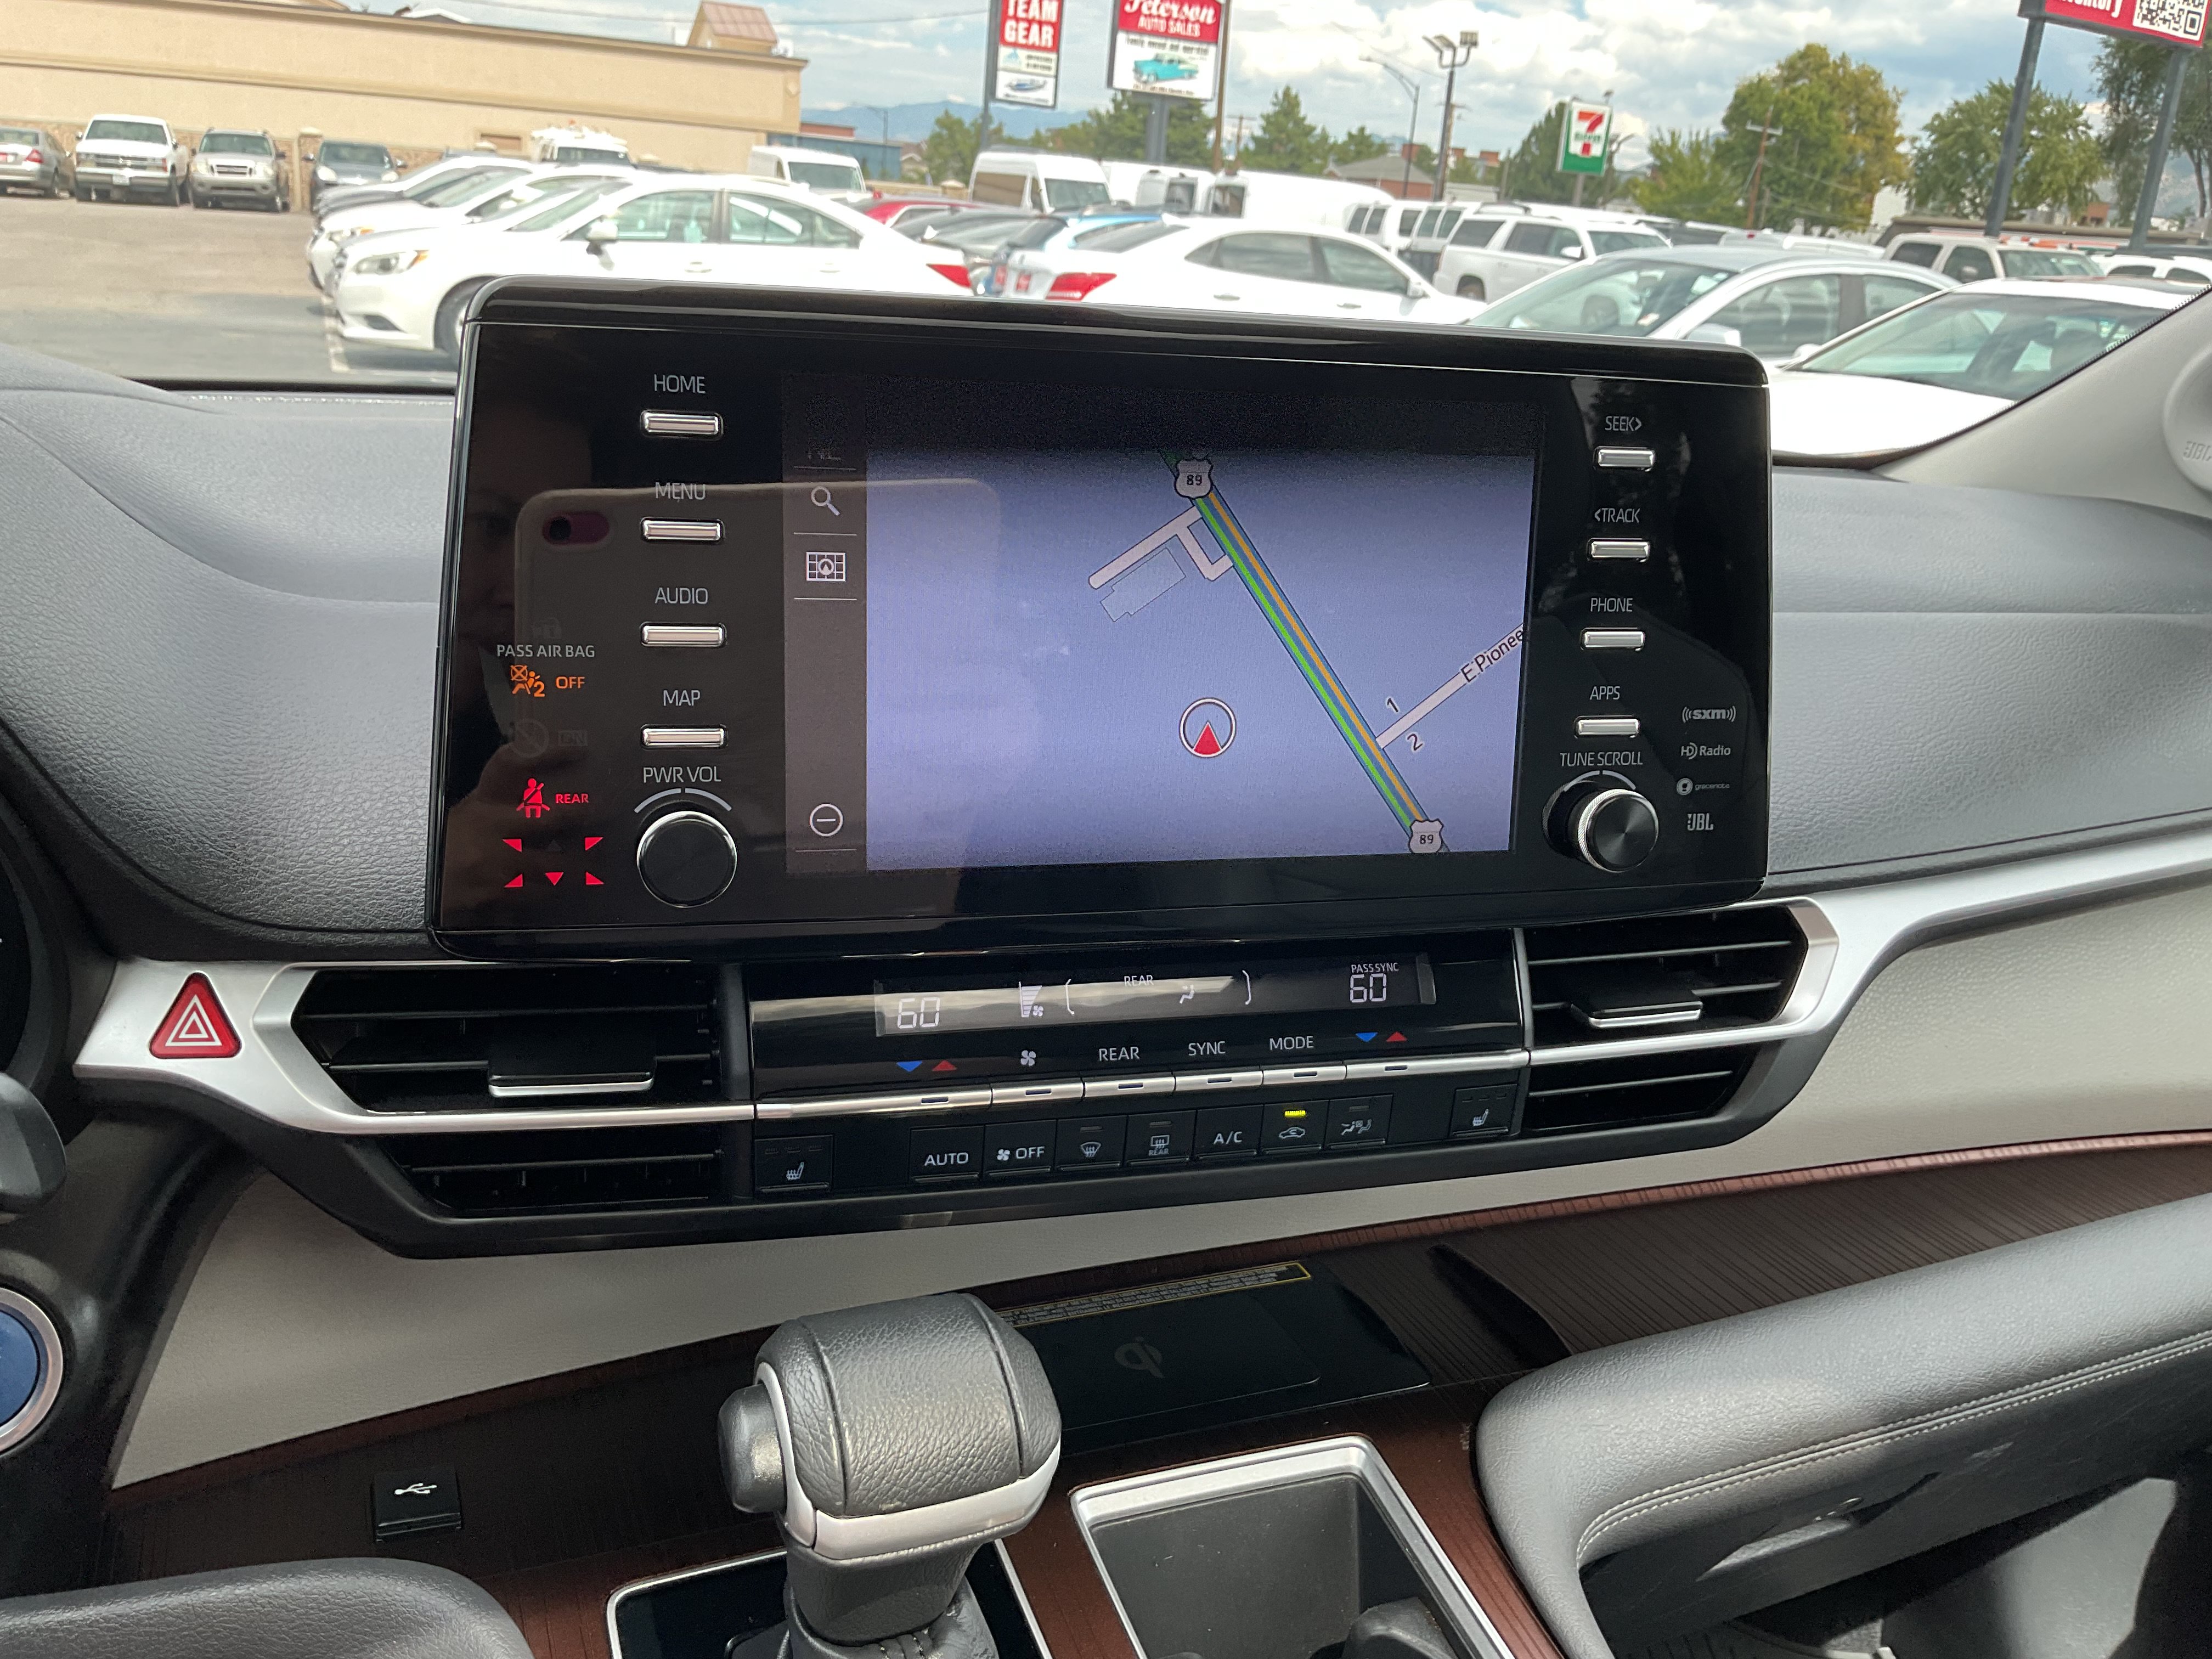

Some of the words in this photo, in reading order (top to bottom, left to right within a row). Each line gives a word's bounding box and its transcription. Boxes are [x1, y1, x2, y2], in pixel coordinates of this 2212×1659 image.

[1004, 18, 1054, 48] GEAR
[1137, 15, 1166, 32] AUTO
[1167, 18, 1200, 37] SALES
[653, 375, 706, 394] HOME
[1187, 475, 1202, 486] 89
[655, 482, 706, 500] MENU
[654, 586, 709, 605] AUDIO
[1590, 597, 1633, 612] PHONE
[496, 645, 534, 658] PASS
[537, 645, 562, 658] AIR
[566, 645, 596, 658] BAG
[1460, 663, 1477, 682] E
[556, 676, 585, 690] OFF
[663, 690, 701, 707] MAP
[1590, 686, 1621, 701] APPS
[1386, 698, 1398, 713] 1
[1692, 709, 1726, 720] sxm
[1408, 734, 1424, 751] 2
[1681, 742, 1698, 759] HD
[1699, 744, 1731, 756] Radio
[1560, 752, 1598, 767] TUNE
[1598, 751, 1644, 766] SCROLL
[643, 767, 684, 783] PWR
[687, 766, 721, 783] VOL
[556, 793, 589, 804] REAR
[1687, 813, 1714, 831] JBL
[1419, 834, 1434, 845] 89
[1351, 963, 1374, 973] PASS
[1375, 962, 1399, 973] SYNC
[1124, 974, 1154, 987] REAR
[1350, 973, 1387, 1003] 60
[897, 996, 941, 1029] 60
[1188, 1041, 1226, 1057] SYNC
[1269, 1035, 1314, 1051] MODE
[1098, 1046, 1140, 1061] REAR
[1213, 1130, 1243, 1145] A/C
[924, 1152, 969, 1167] AUTO
[1015, 1146, 1045, 1160] OFF
